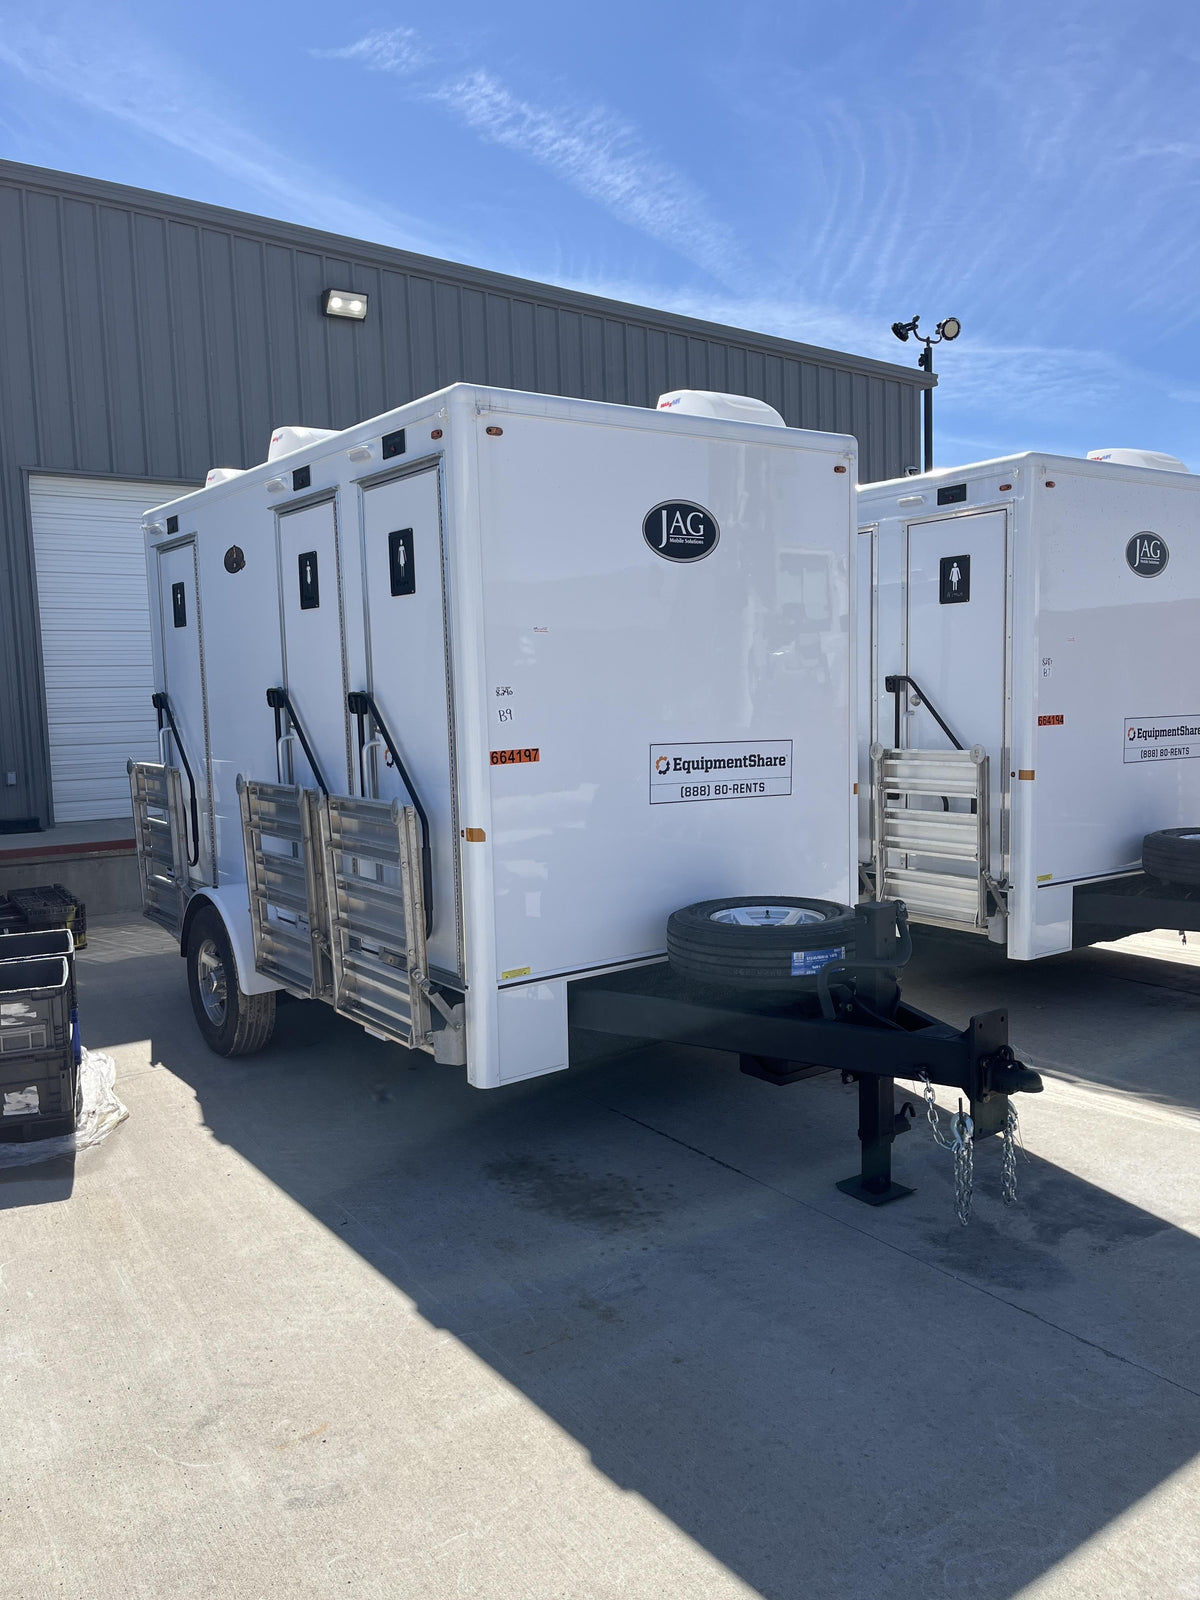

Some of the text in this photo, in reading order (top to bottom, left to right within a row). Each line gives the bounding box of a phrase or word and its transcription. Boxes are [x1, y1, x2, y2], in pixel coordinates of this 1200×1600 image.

[658, 509, 704, 549] JAG
[1133, 538, 1160, 567] JAG
[498, 708, 513, 722] B9
[1038, 715, 1064, 726] 664194
[490, 748, 539, 765] 664197
[1140, 746, 1190, 759] (888) 80-RENTS
[672, 754, 786, 774] EquipmentShare
[680, 782, 765, 798] (888) 80-RENTS
